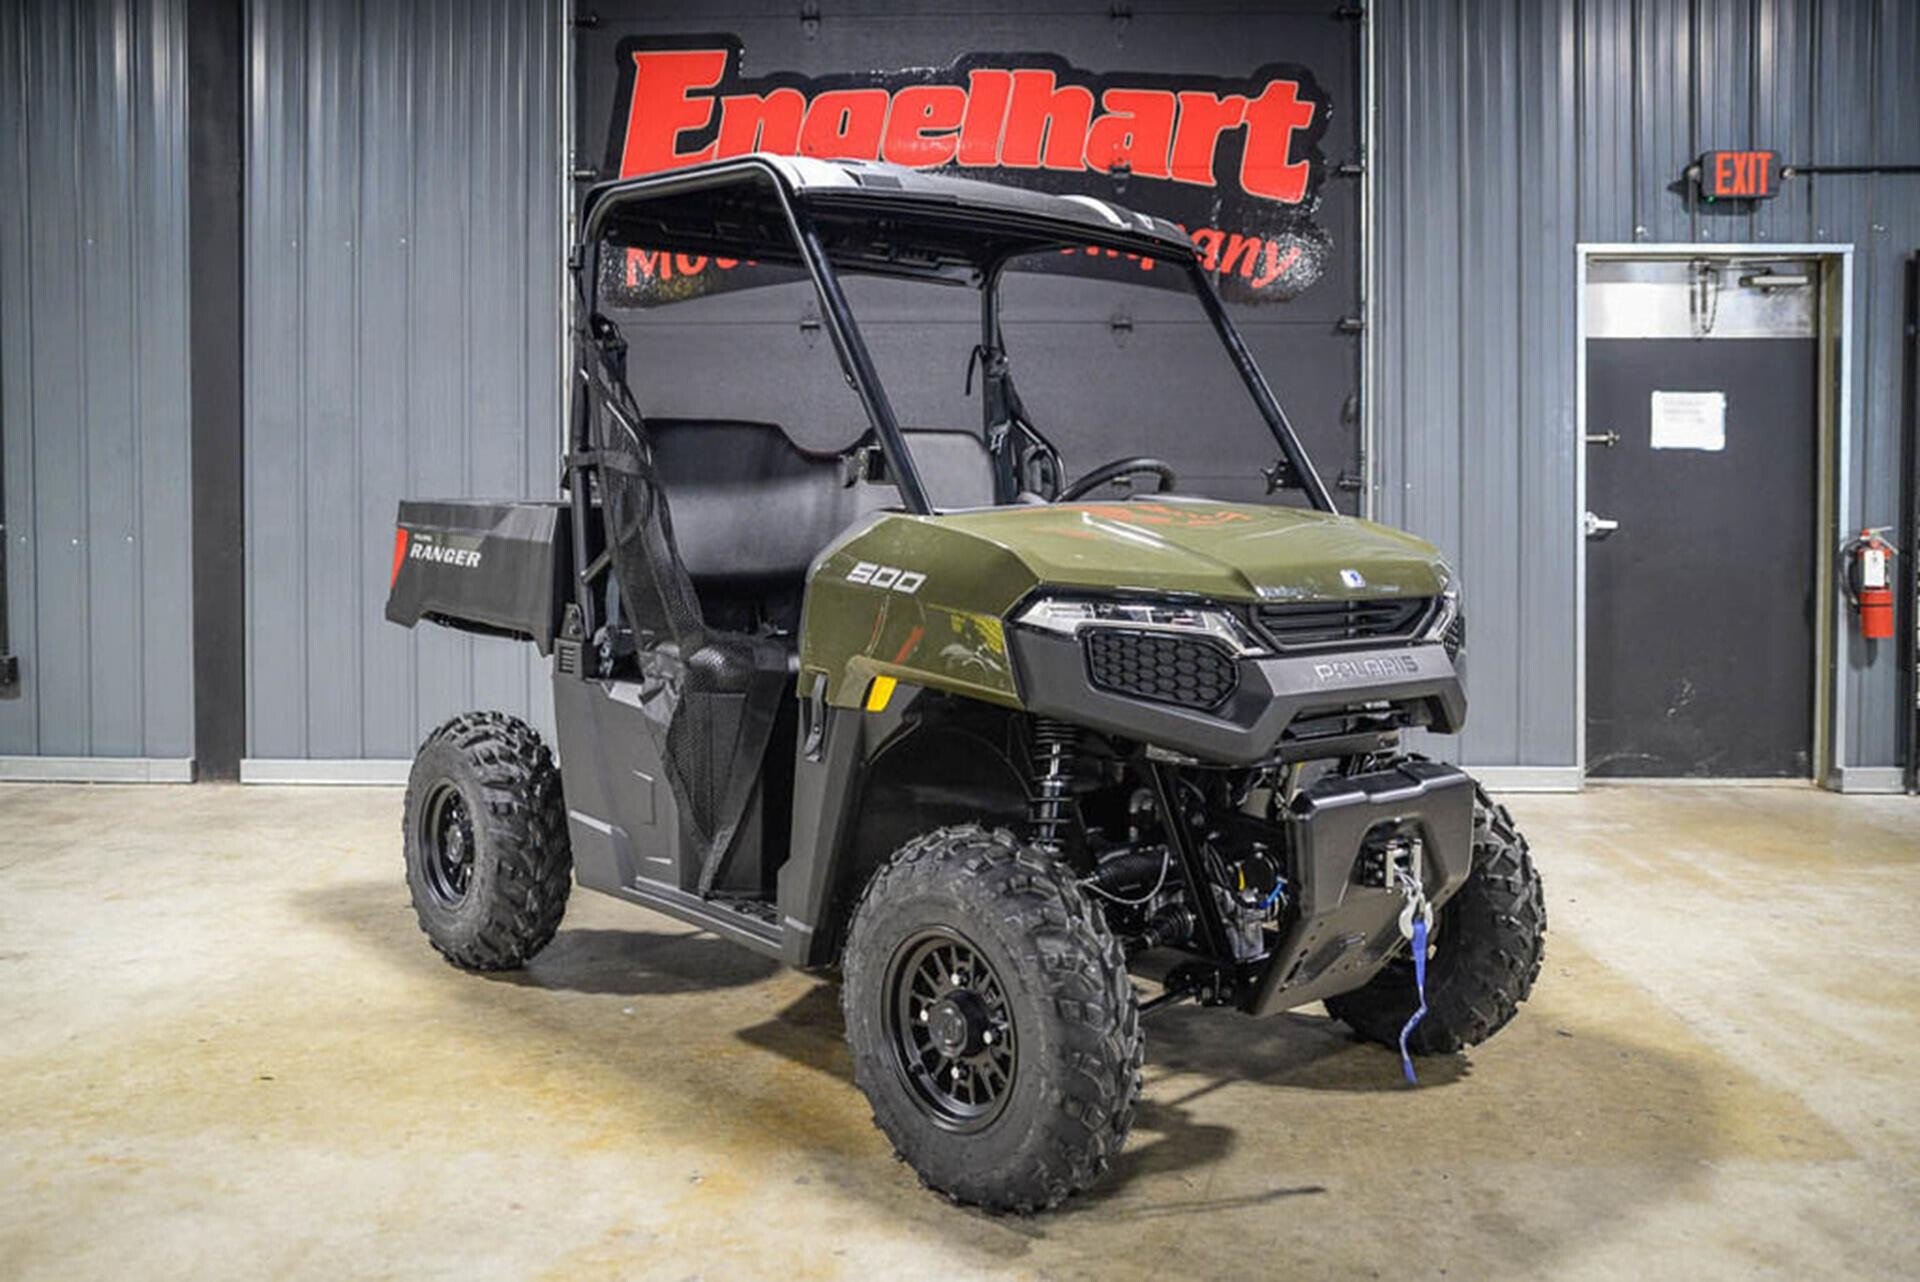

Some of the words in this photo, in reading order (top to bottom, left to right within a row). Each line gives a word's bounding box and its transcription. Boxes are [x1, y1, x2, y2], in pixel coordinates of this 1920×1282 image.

[619, 50, 1316, 203] Engelhart
[1715, 152, 1772, 194] EXIT
[410, 543, 481, 567] RANGER
[847, 562, 926, 593] 500
[1315, 655, 1418, 681] POLARIS
